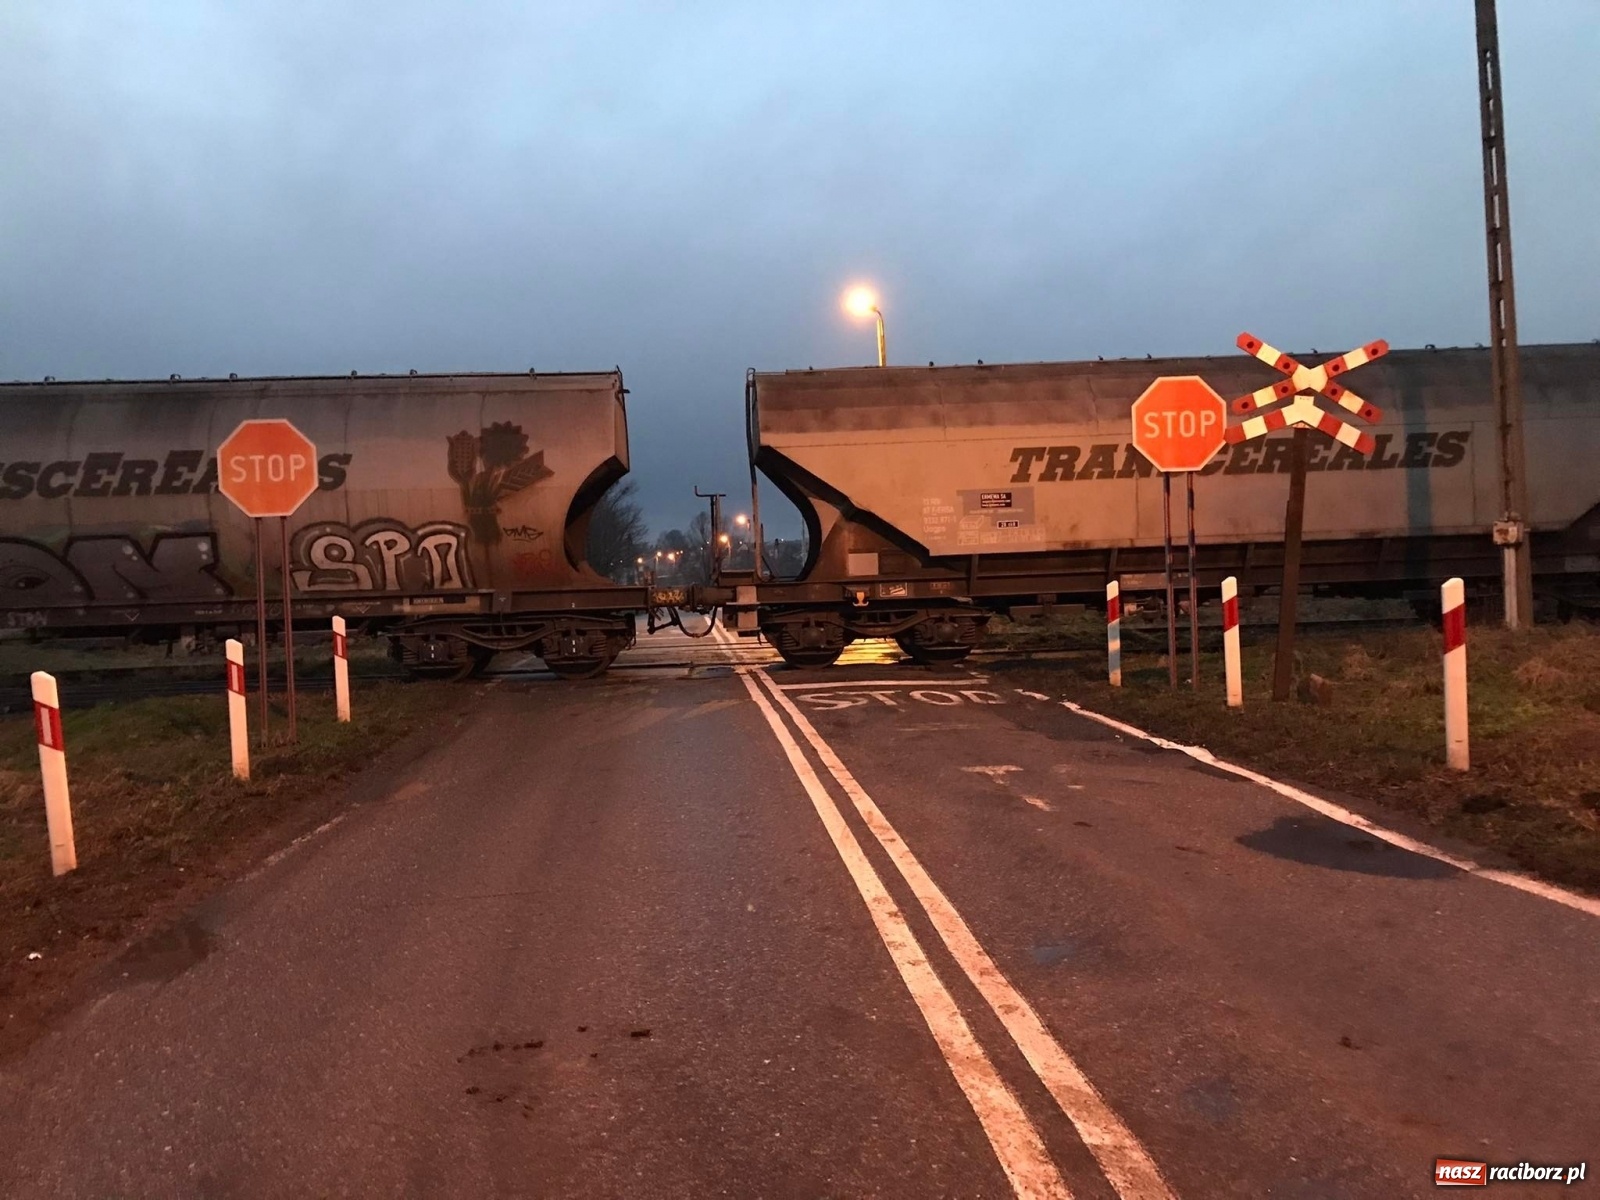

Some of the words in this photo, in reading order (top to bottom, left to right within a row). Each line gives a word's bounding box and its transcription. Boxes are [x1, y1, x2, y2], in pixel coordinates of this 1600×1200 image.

[1143, 409, 1217, 439] STOP
[229, 453, 307, 484] STOP
[796, 689, 1007, 711] STOP
